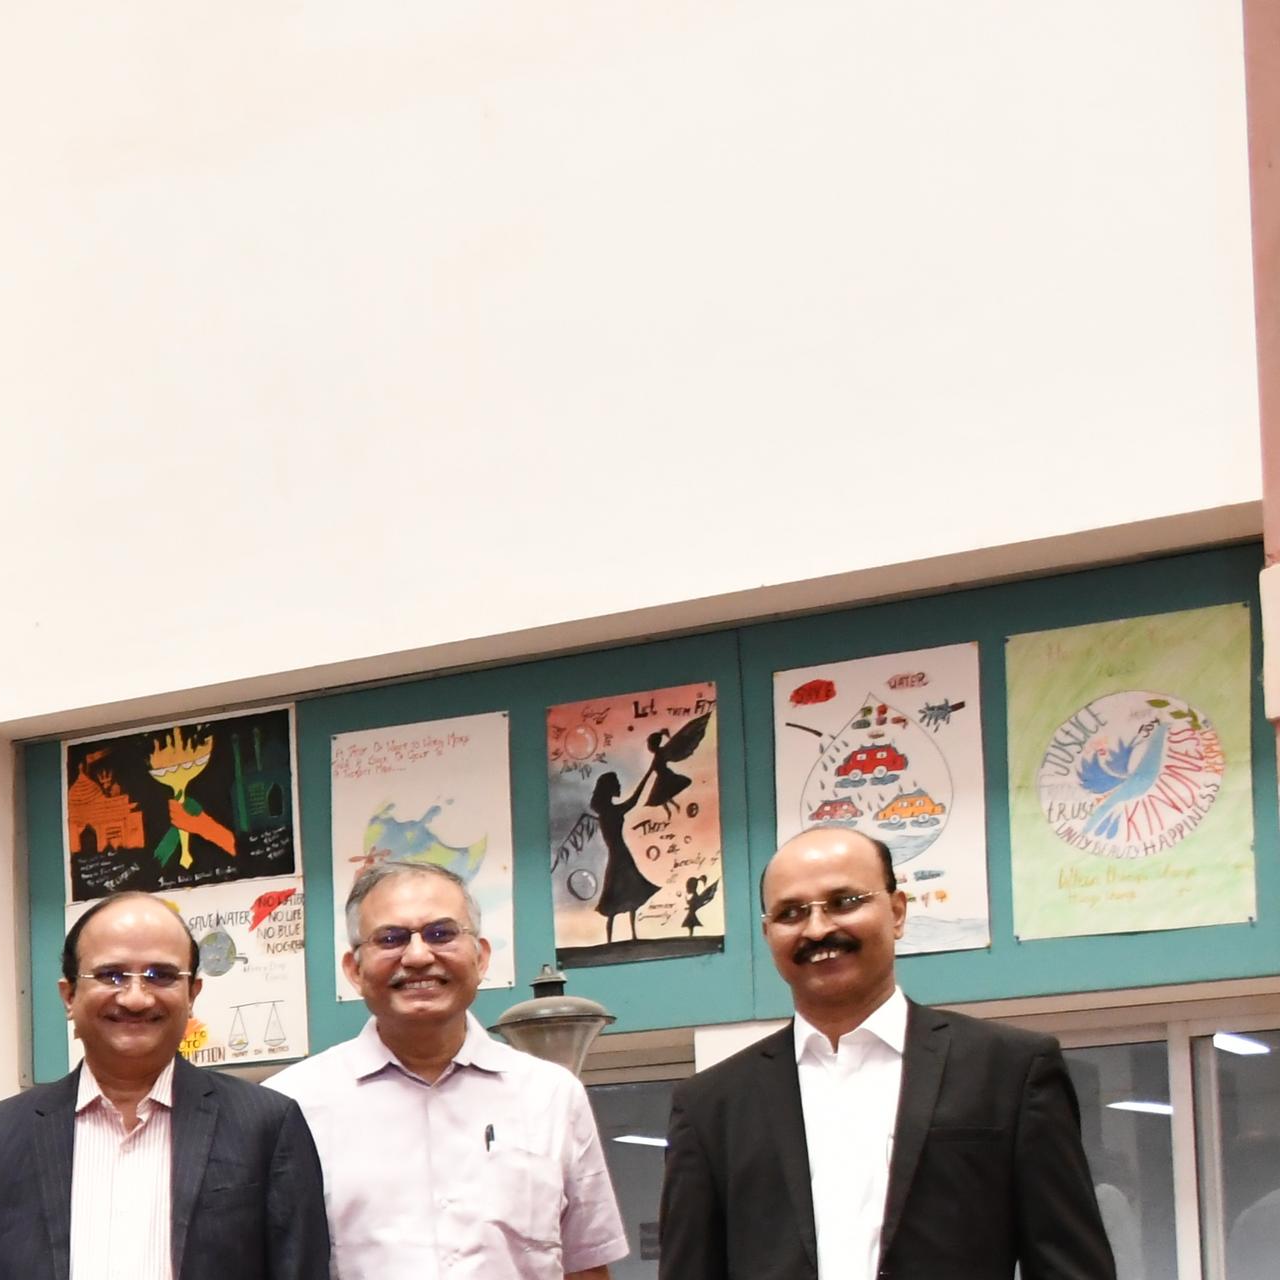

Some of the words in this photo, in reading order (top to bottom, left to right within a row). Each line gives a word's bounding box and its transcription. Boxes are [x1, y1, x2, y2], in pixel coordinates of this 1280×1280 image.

[633, 697, 658, 719] Let
[1123, 727, 1206, 843] KINDNESS
[1142, 782, 1220, 857] HAPPINESS
[188, 913, 214, 931] SAVE
[215, 908, 252, 927] WATER
[268, 911, 284, 923] NO
[286, 908, 302, 922] LIFE
